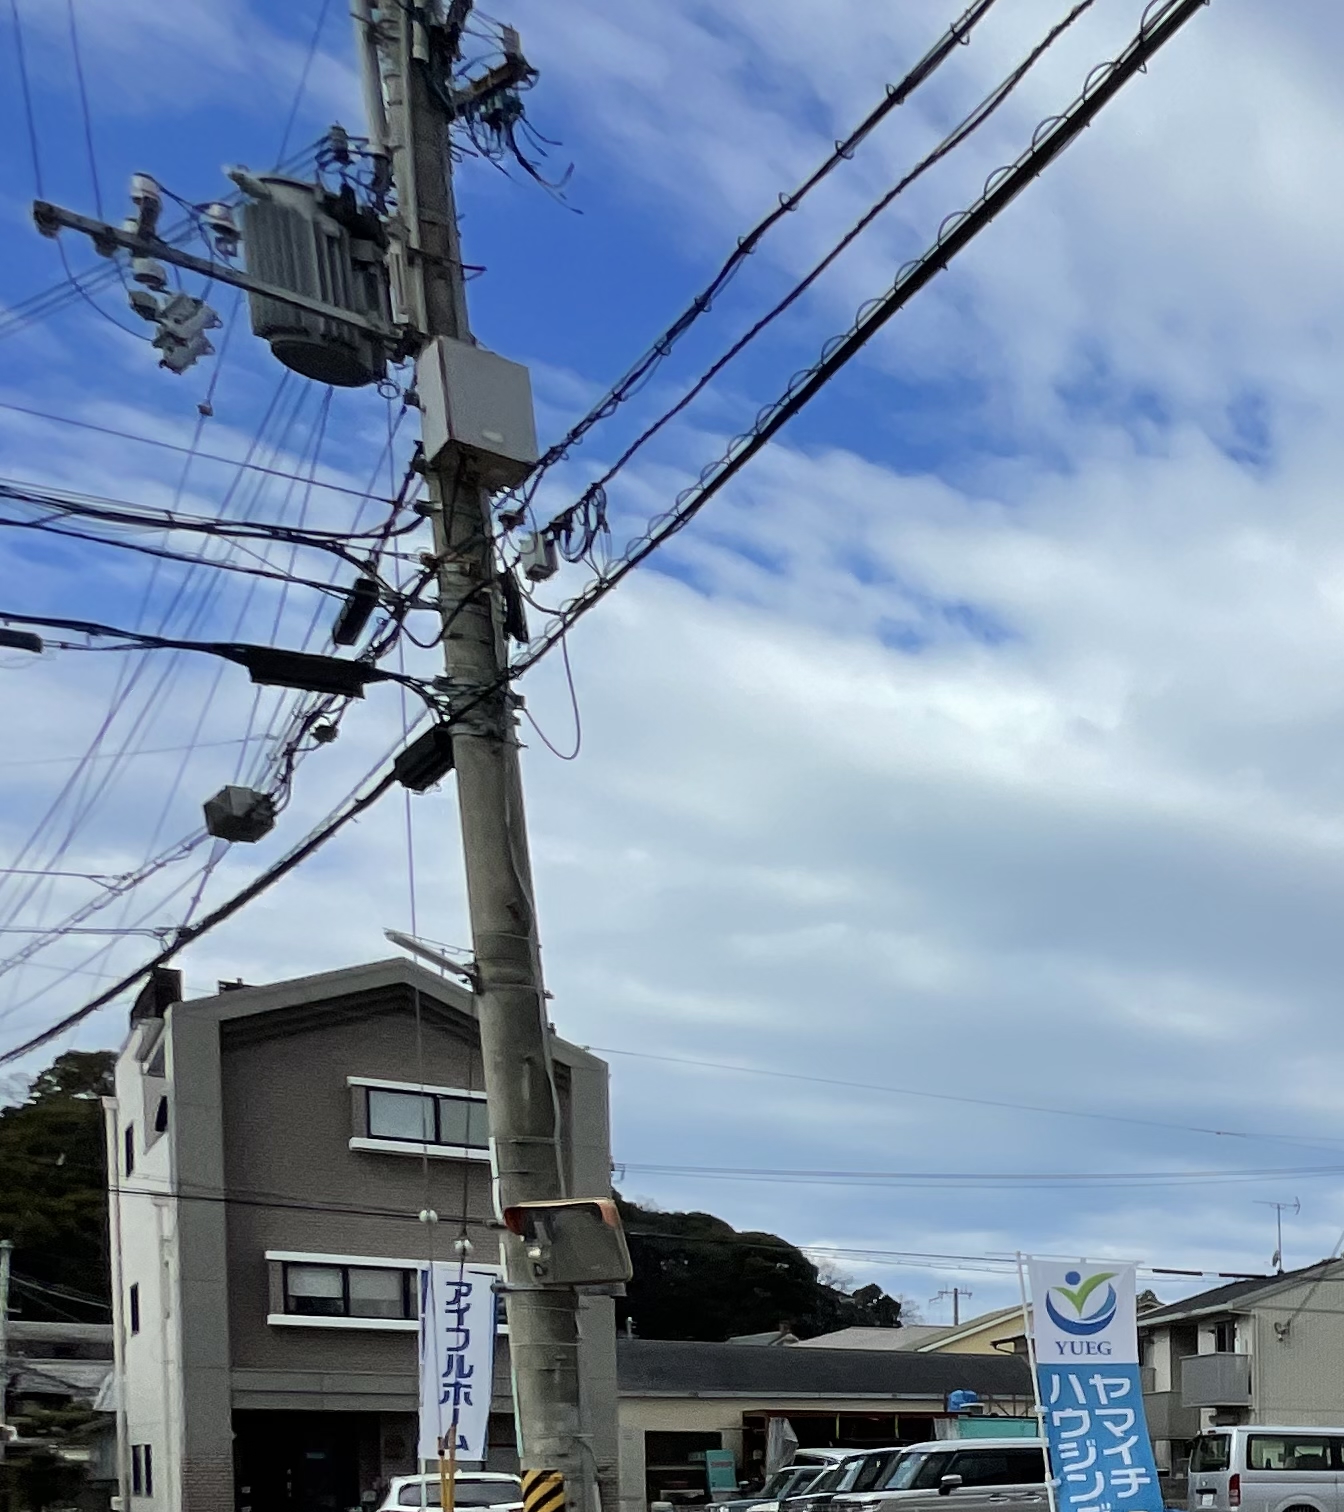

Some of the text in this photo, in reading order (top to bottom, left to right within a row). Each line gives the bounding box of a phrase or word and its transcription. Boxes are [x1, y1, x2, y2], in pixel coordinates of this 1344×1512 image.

[1055, 1341, 1112, 1355] YUEG
[1089, 1373, 1151, 1499] ヤマイチ
